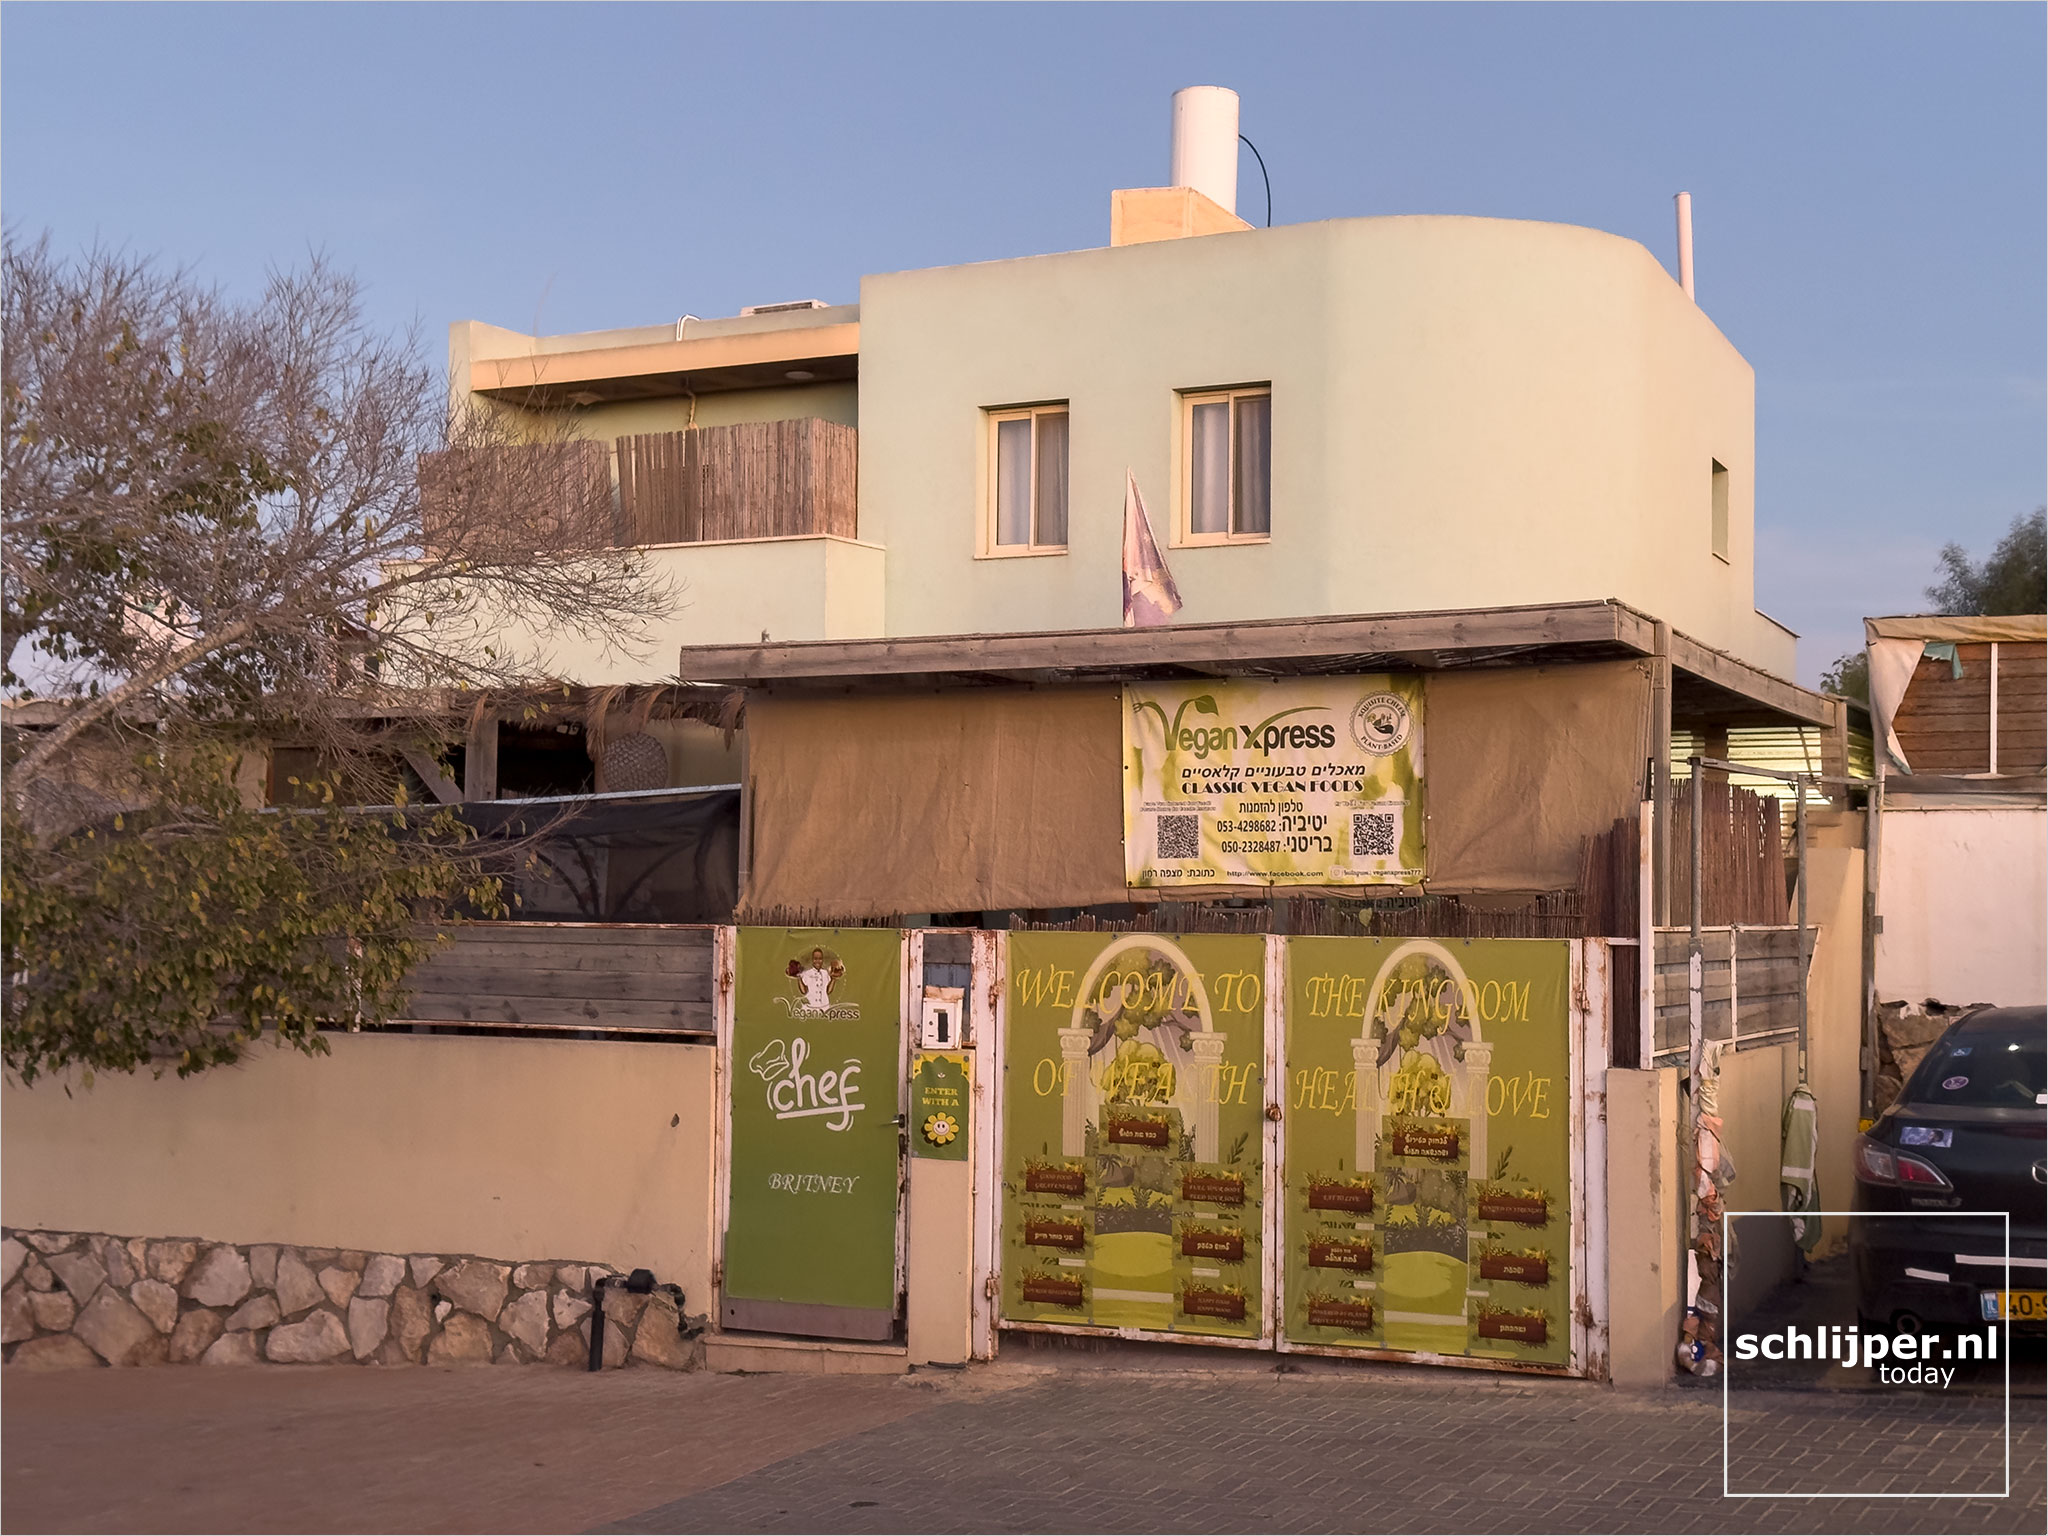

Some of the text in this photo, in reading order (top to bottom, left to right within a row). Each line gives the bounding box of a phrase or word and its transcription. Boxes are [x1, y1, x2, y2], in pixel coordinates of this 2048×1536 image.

[1182, 763, 1365, 780] מאכלים טבעוניים קלאסיים
[1182, 780, 1364, 794] CLASSIC VEGAN FOODS
[1239, 799, 1303, 816] טלפון להזמנות
[1217, 820, 1276, 832] 053-4298682
[1221, 841, 1281, 853] 050-2328487
[1142, 869, 1215, 879] כתובת: מצפה רמון
[1016, 964, 1262, 1015] WELCOME TO
[1305, 972, 1532, 1035] THE KINGDOM
[1033, 1058, 1082, 1096] OF
[924, 1087, 958, 1096] ENTER
[922, 1097, 950, 1106] WITH
[768, 1173, 860, 1194] BRITNEY
